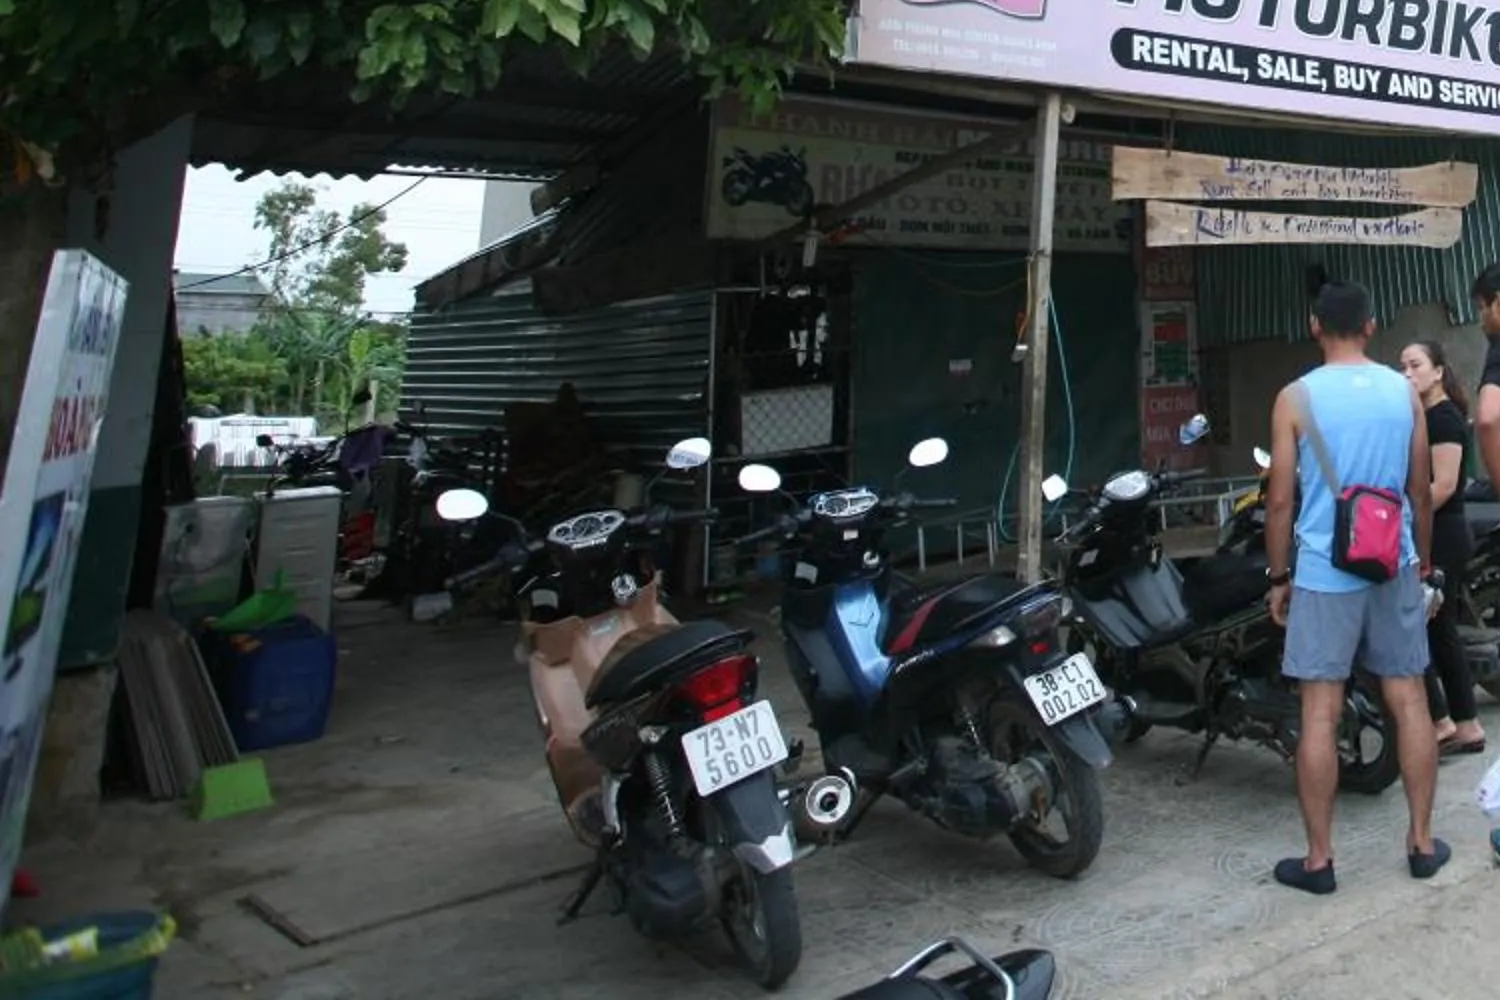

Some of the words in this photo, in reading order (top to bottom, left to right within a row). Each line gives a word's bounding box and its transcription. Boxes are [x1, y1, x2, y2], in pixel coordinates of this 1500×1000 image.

[1131, 34, 1250, 83] RENTAL,
[1257, 53, 1328, 92] SALE,
[1334, 64, 1382, 93] BUY
[1388, 73, 1433, 101] AND
[705, 736, 773, 786] 5600
